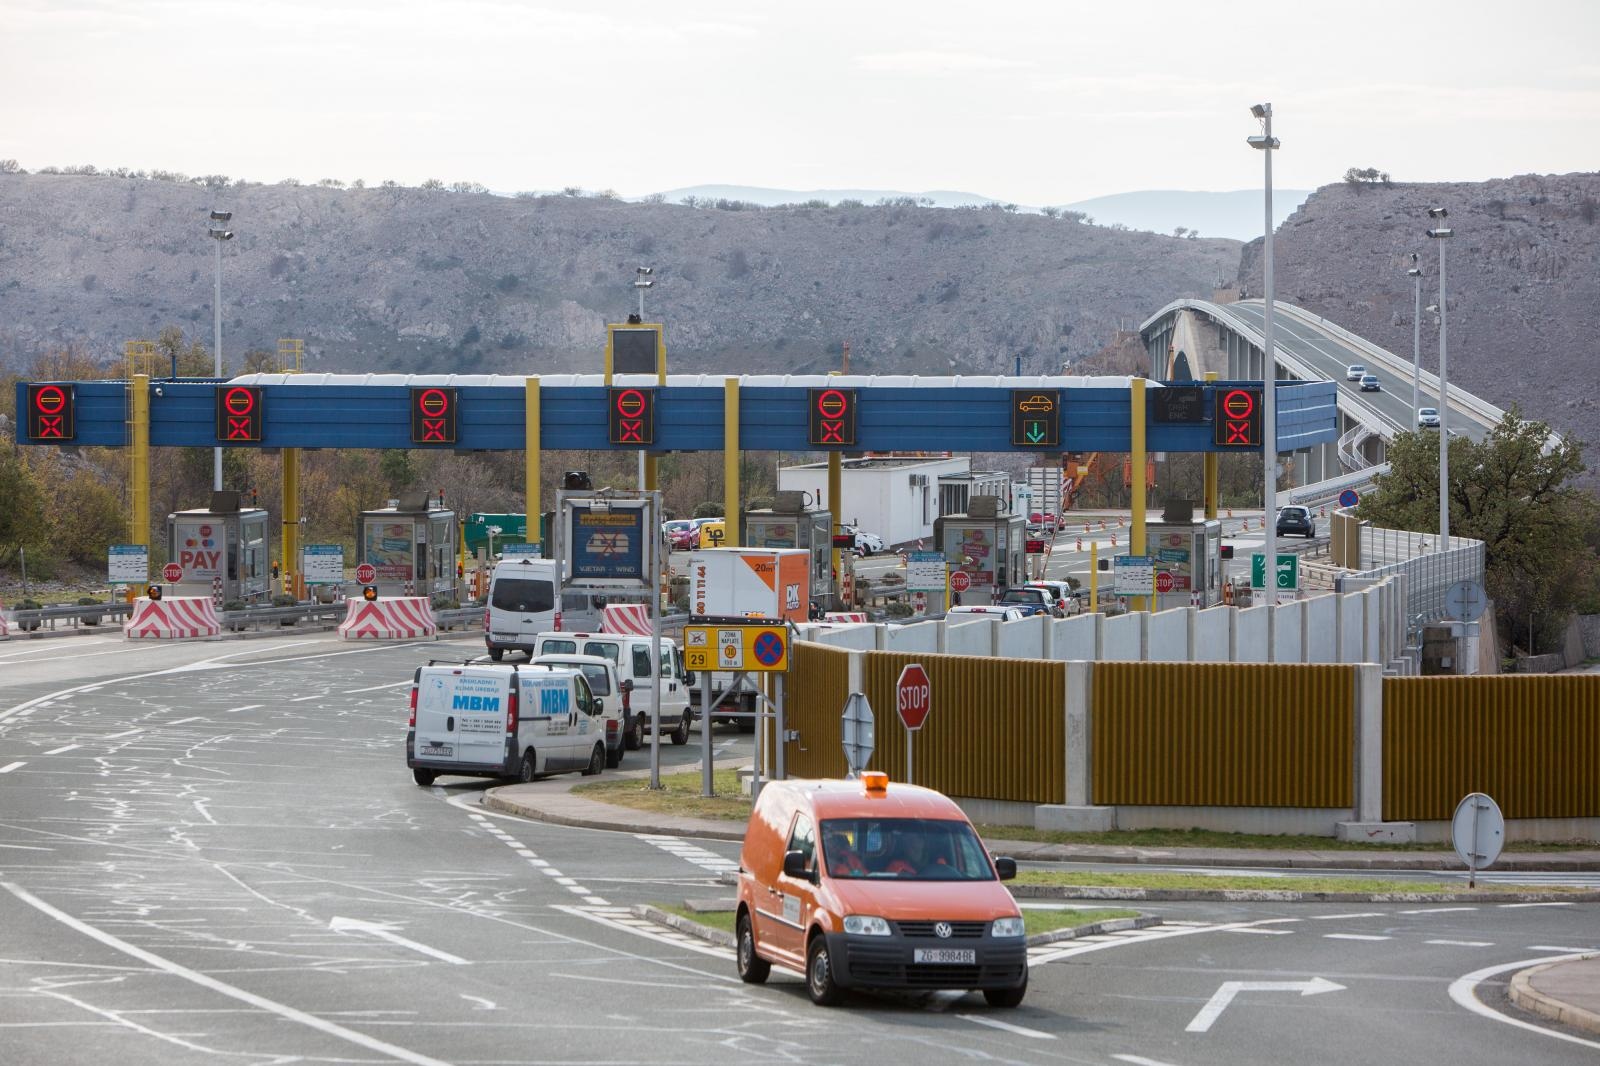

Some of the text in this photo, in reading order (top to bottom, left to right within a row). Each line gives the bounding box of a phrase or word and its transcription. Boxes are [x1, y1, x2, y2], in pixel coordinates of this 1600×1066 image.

[180, 551, 221, 569] PAY
[164, 568, 182, 578] STOP
[357, 569, 375, 578] STOP
[951, 577, 969, 586] STOP
[1156, 579, 1173, 587] STOP
[786, 584, 800, 603] DK
[786, 601, 800, 610] AUTO
[690, 654, 705, 665] 29
[541, 688, 569, 714] MBM
[900, 685, 928, 710] STOP
[452, 695, 500, 712] MBM
[921, 951, 933, 961] ZG
